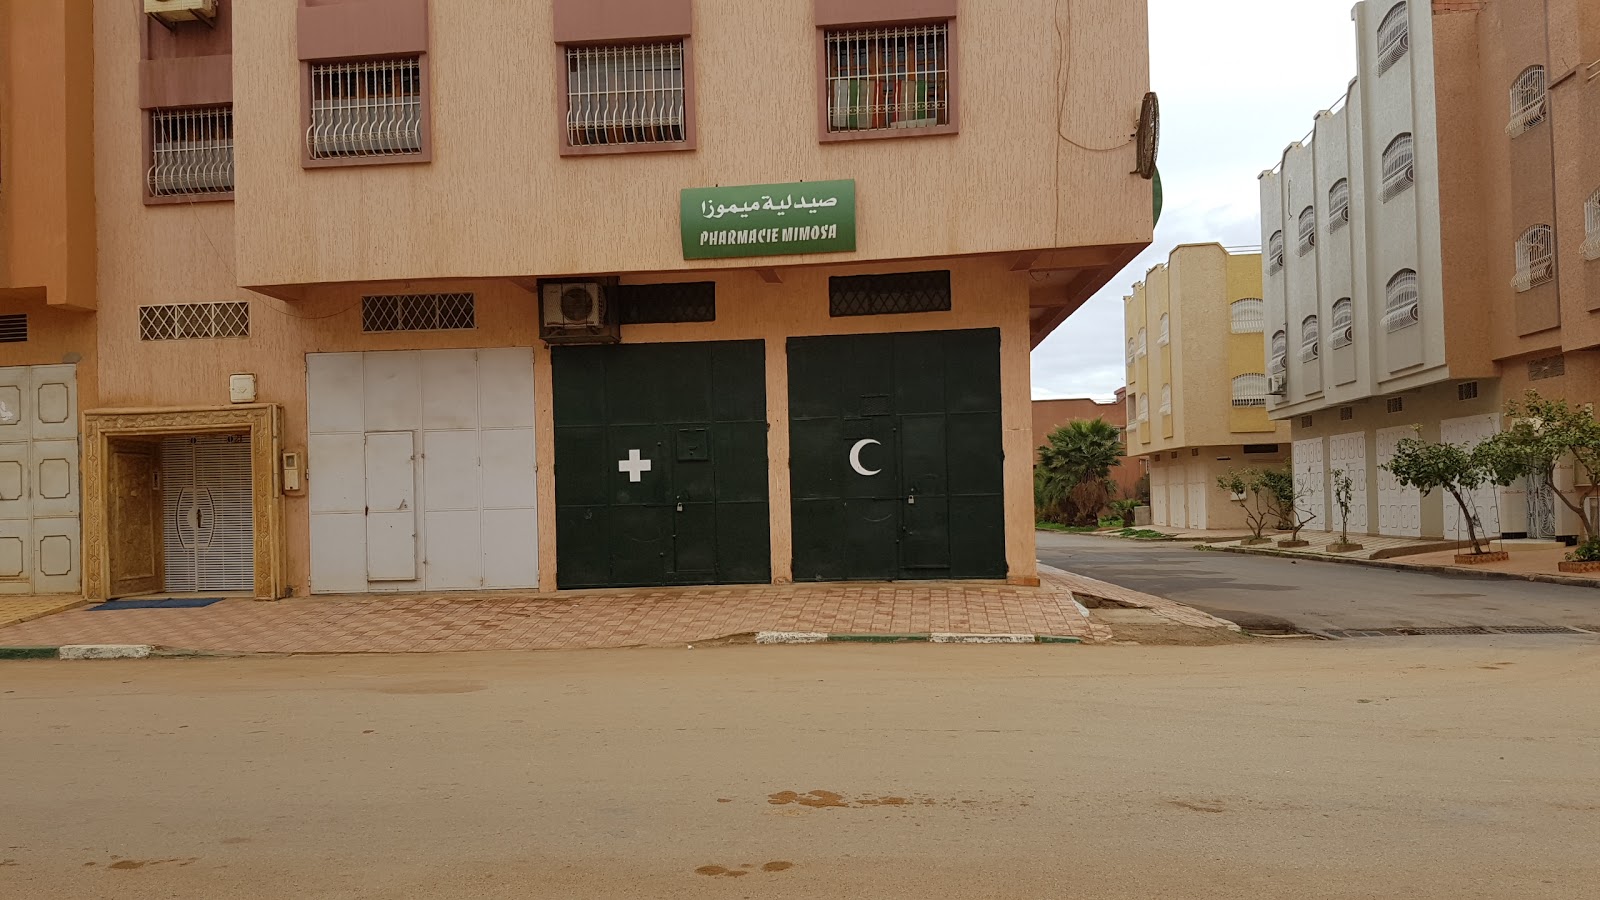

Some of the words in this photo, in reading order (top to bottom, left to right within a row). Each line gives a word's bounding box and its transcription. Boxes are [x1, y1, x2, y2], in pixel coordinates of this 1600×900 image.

[701, 199, 760, 218] ميموزا
[762, 194, 838, 216] صيدلية
[700, 227, 779, 246] PHARMACIE
[782, 223, 837, 242] MIMOSA
